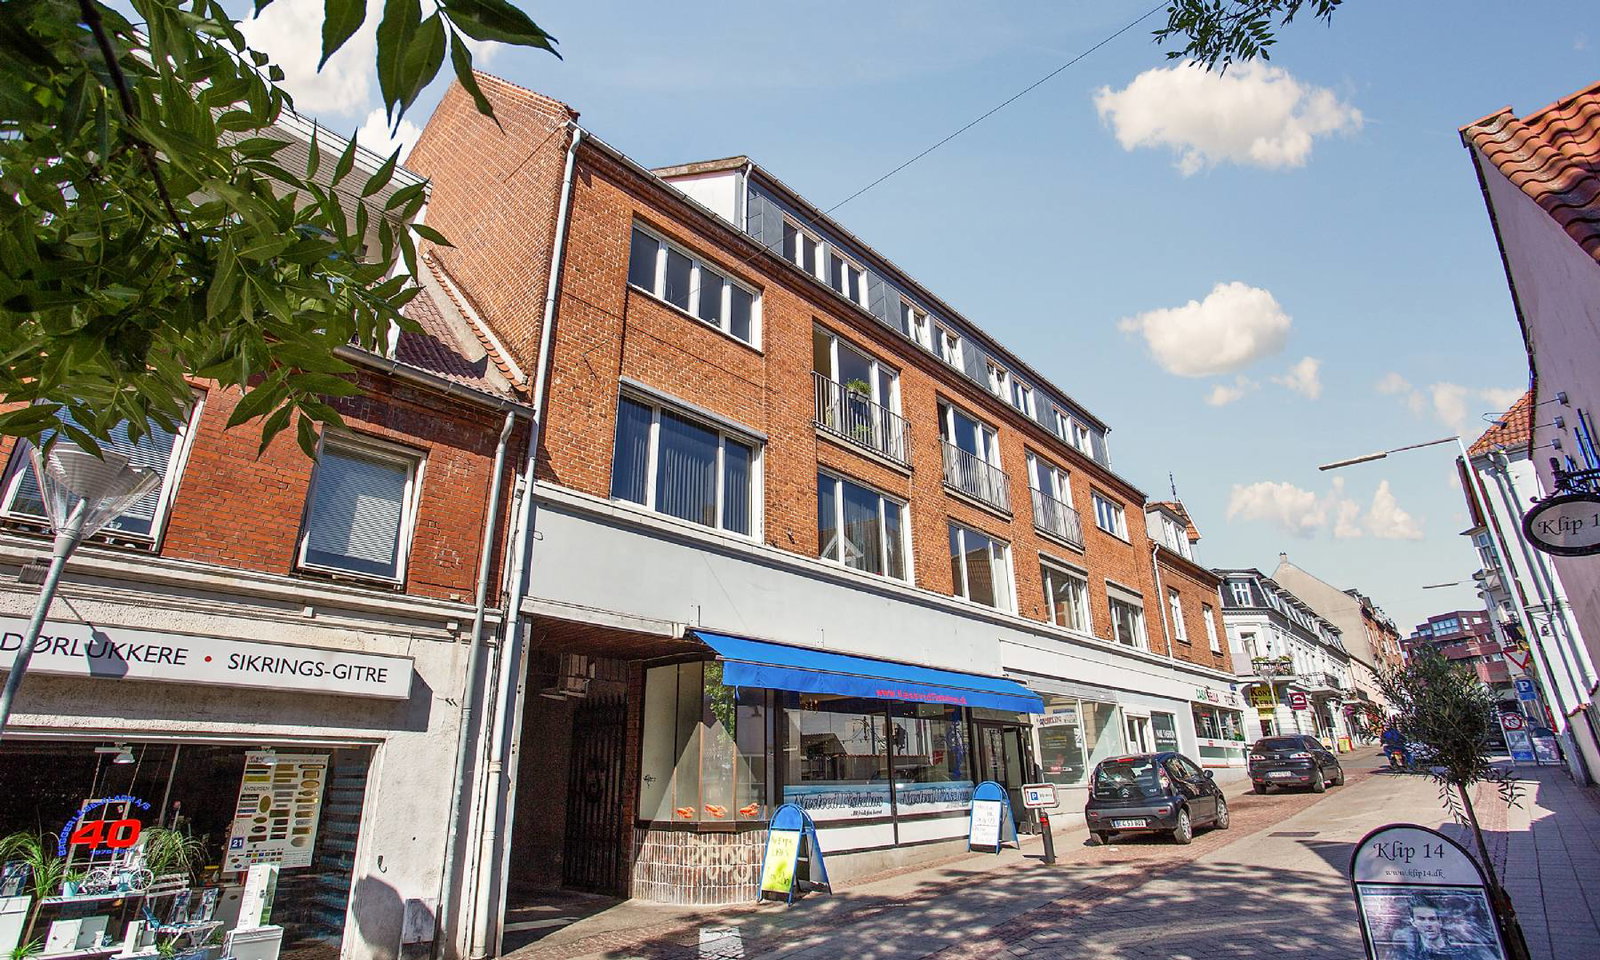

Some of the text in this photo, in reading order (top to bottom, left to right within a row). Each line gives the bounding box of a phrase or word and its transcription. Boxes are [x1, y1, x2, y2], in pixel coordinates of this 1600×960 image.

[1538, 515, 1583, 535] Klip
[0, 632, 188, 666] DØRLUKKERE
[228, 653, 388, 683] SIKRINGS-GITRE
[1520, 681, 1530, 691] P
[70, 819, 141, 848] 40
[232, 839, 242, 847] 21
[1373, 841, 1444, 863] Klip 14
[1385, 868, 1446, 879] www.klip14.dk
